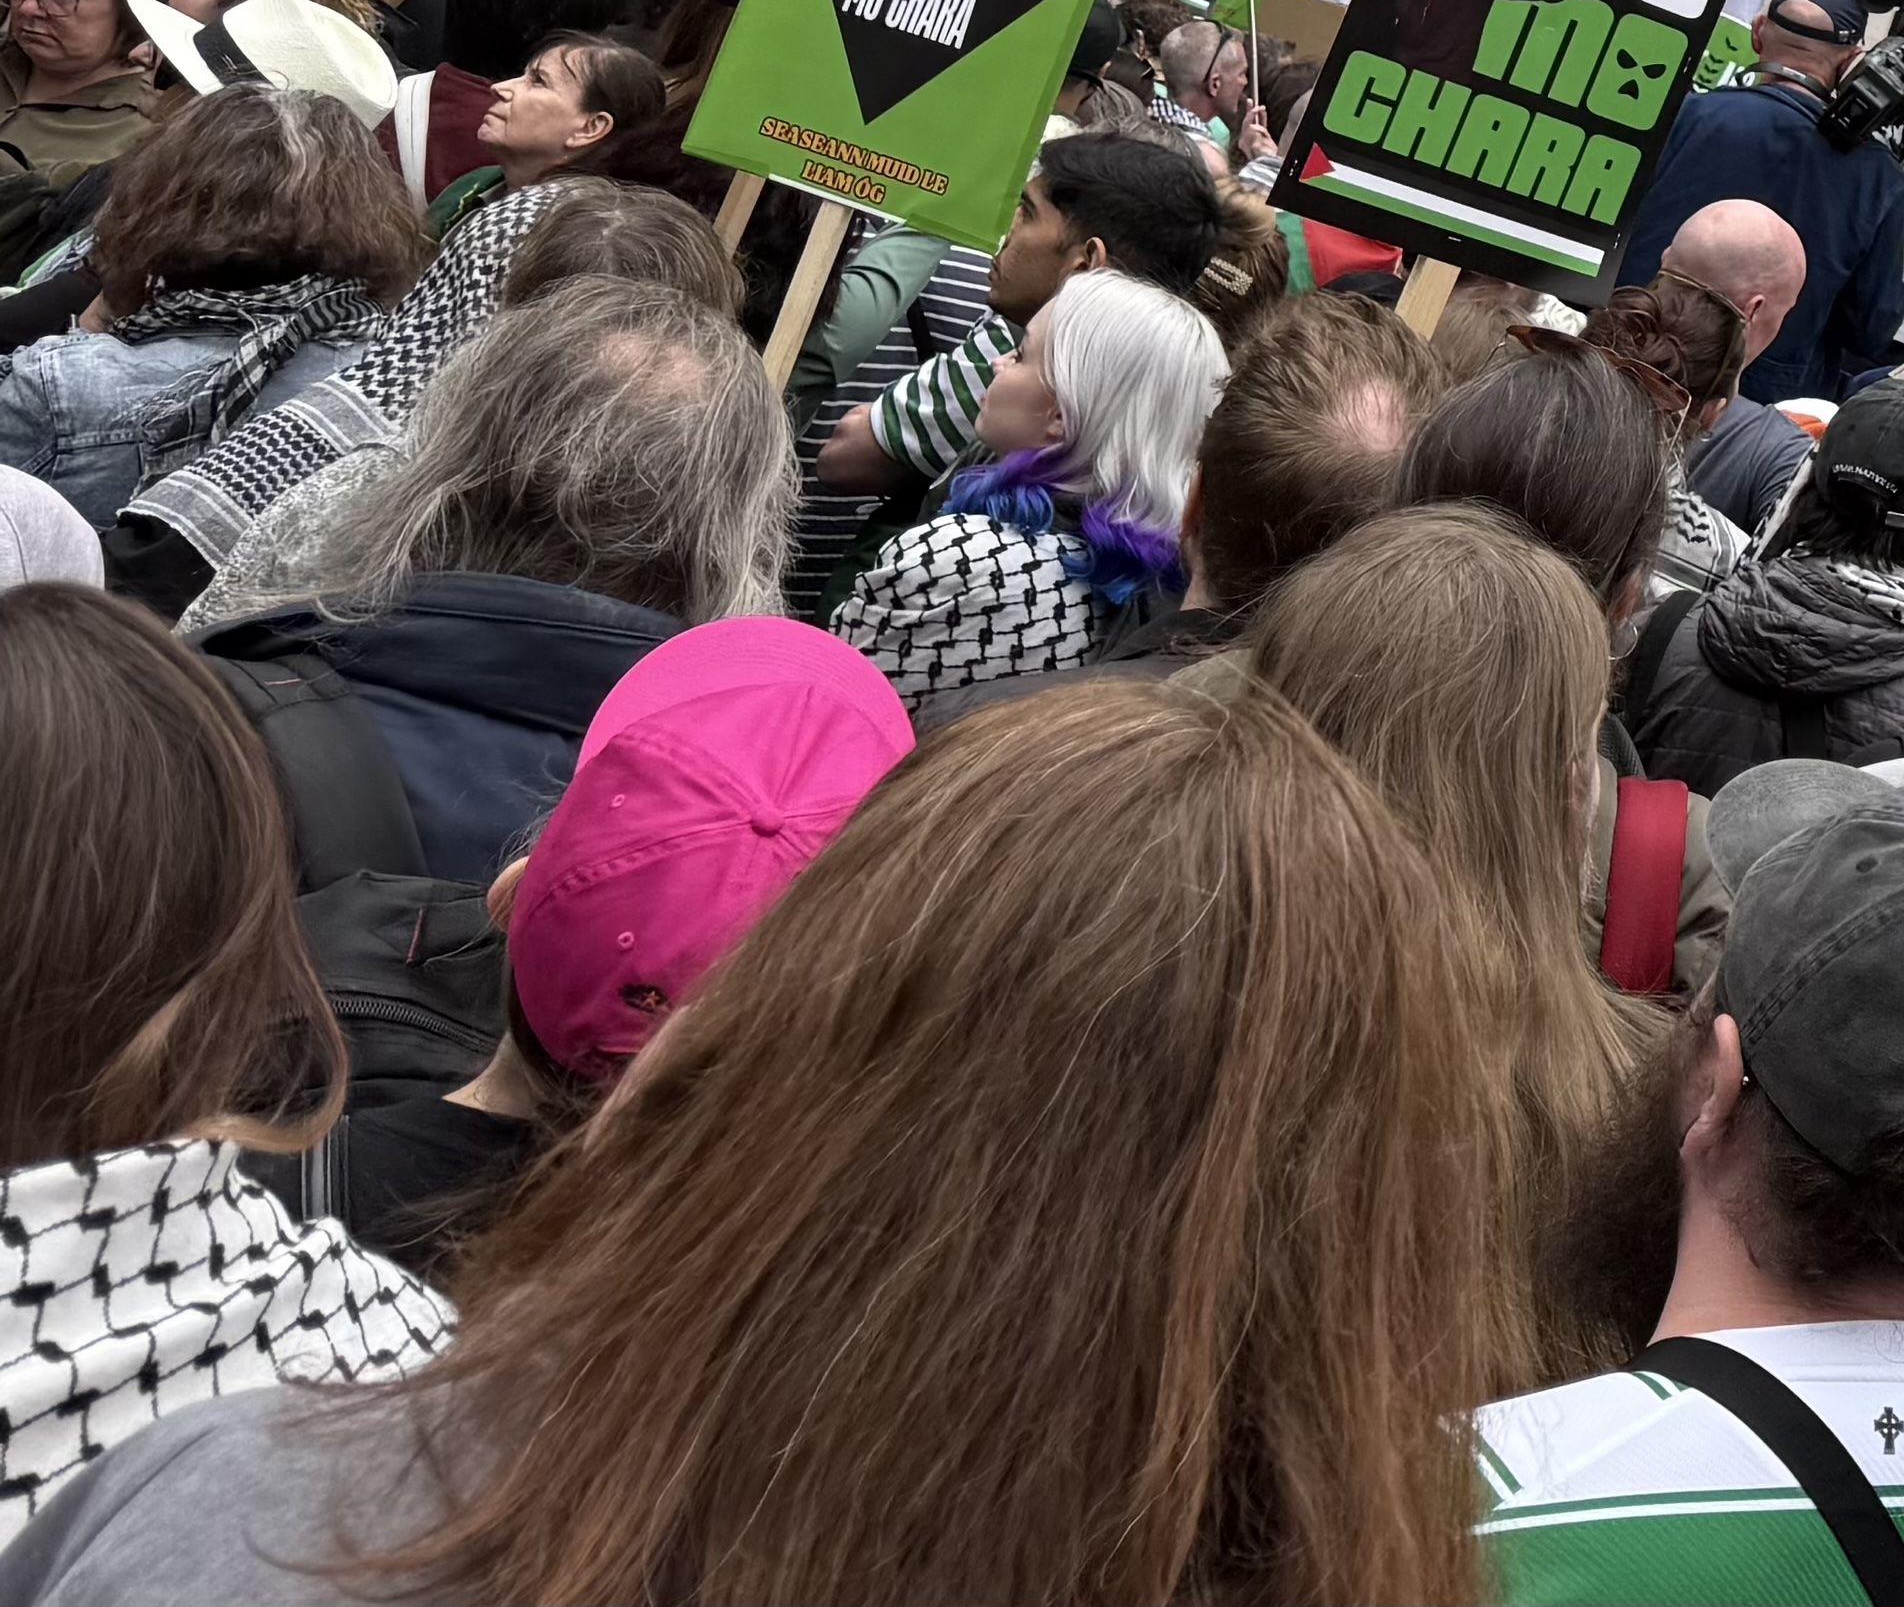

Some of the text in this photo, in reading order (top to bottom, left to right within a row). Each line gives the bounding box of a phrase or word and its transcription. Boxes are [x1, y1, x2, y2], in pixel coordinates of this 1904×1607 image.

[1322, 49, 1642, 227] CHARA
[801, 160, 854, 194] LIAM
[864, 150, 922, 187] MUID
[918, 168, 949, 196] LE
